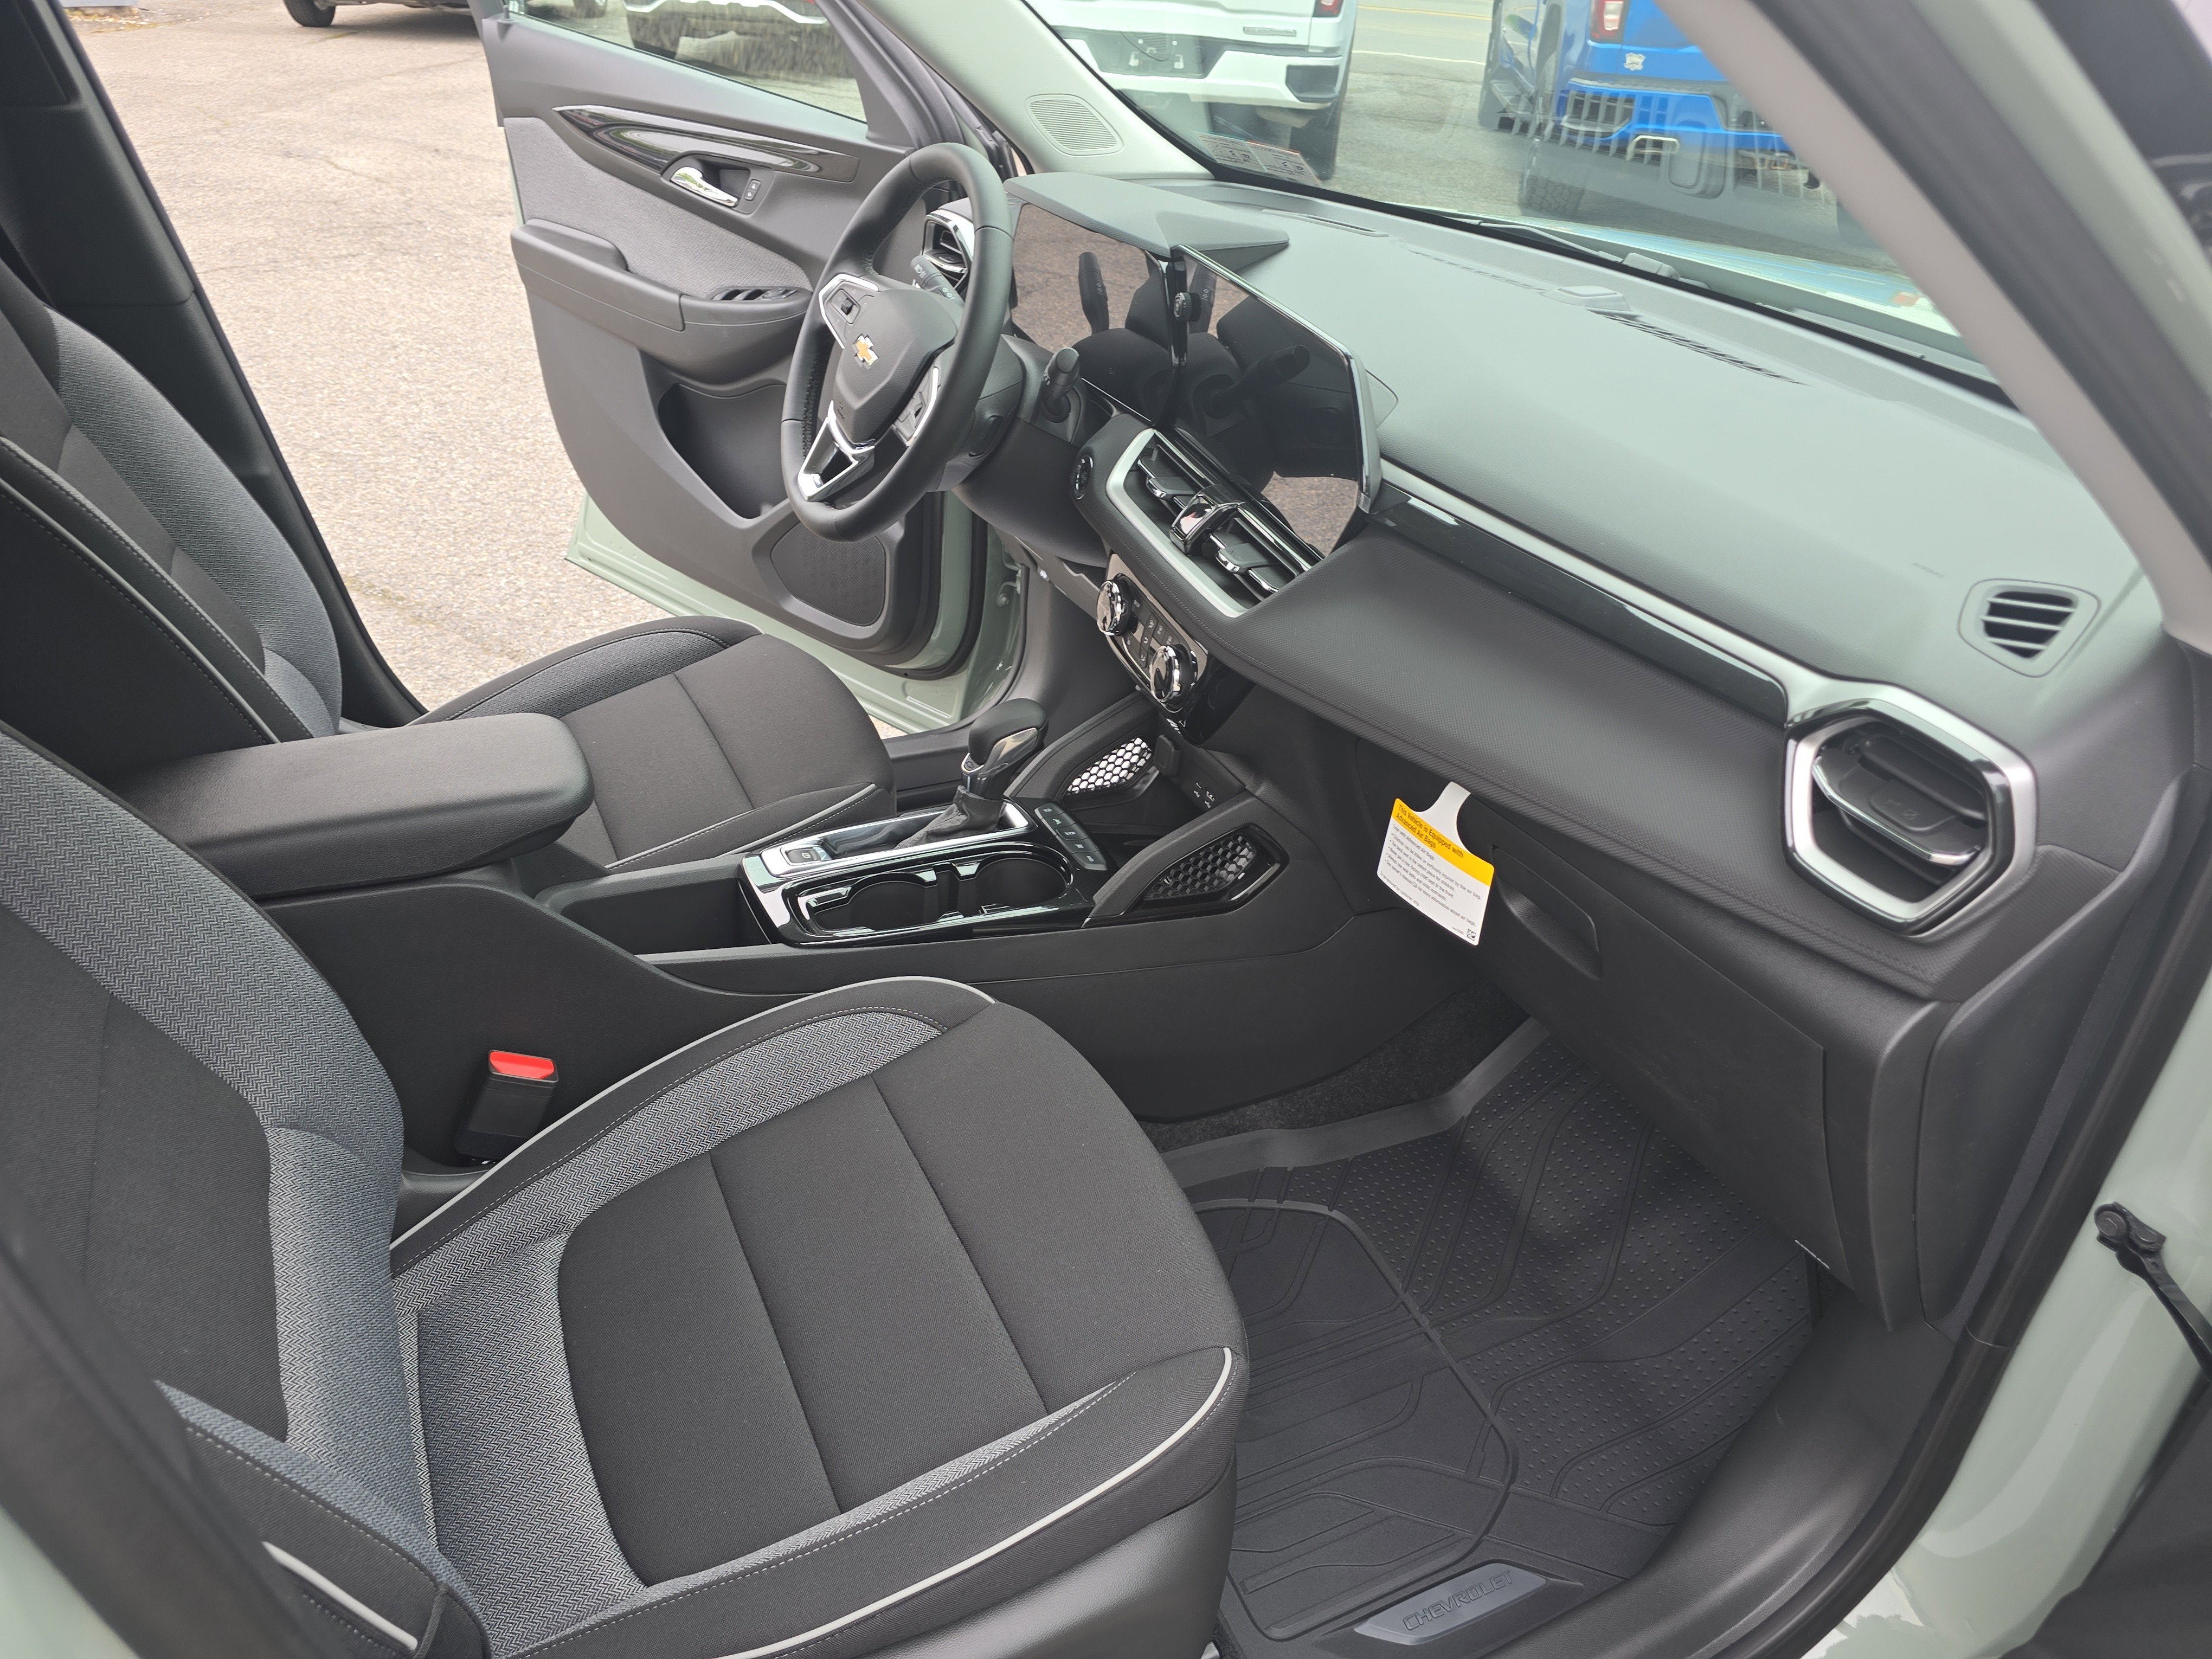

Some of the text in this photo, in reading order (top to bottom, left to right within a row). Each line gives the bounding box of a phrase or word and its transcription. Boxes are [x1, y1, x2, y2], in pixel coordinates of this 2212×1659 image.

[1396, 812, 1417, 833] Advanced
[1424, 835, 1436, 848] Bags
[1407, 812, 1423, 829] Vehicle
[1429, 829, 1451, 850] Equipped
[1452, 847, 1463, 858] with
[1403, 1570, 1513, 1631] CHEVROLET
